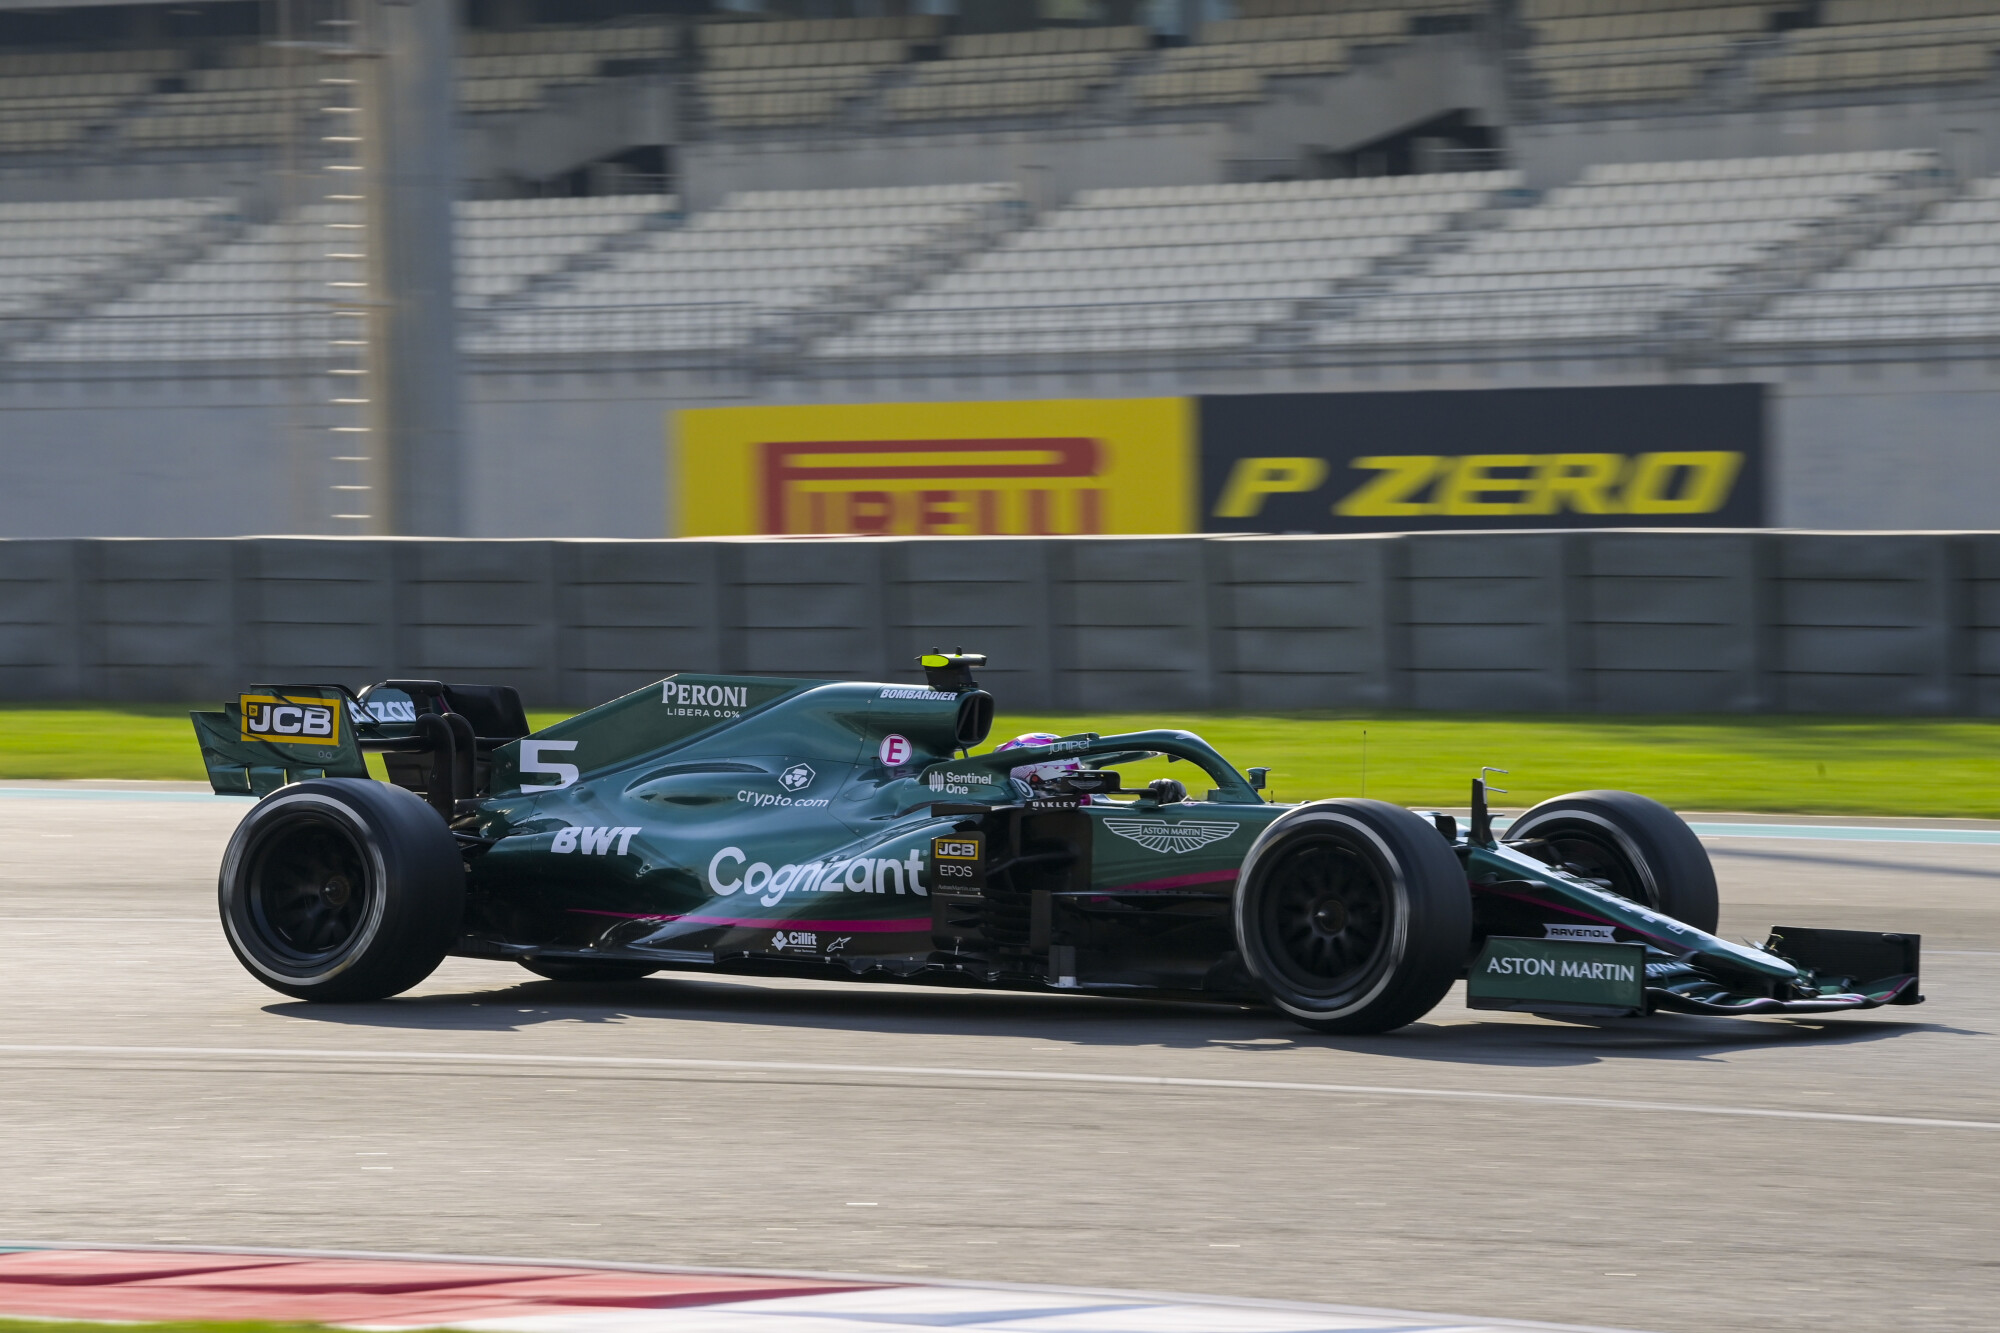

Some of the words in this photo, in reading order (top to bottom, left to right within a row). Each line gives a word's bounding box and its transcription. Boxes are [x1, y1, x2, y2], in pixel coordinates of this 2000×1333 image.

[1212, 457, 1328, 517] P
[1332, 451, 1744, 516] ZERO
[661, 680, 748, 707] PERONI
[880, 689, 958, 701] BOMBARDIER
[248, 705, 332, 735] JCB
[667, 707, 710, 717] LIBERA
[713, 710, 740, 719] 0.0%
[886, 737, 904, 763] E
[519, 739, 580, 794] 5
[946, 772, 992, 785] Sentinel
[946, 783, 969, 795] One
[736, 788, 830, 809] crypto.com
[1142, 826, 1170, 835] ASTON
[1171, 828, 1201, 836] MARTIN
[550, 826, 643, 857] BWT
[938, 842, 975, 856] JCB
[708, 846, 929, 908] Cognizant
[940, 864, 973, 877] EPOS
[788, 931, 817, 945] Cillit
[1550, 928, 1609, 938] RAVENOL
[1486, 956, 1555, 976] ASTON
[1560, 960, 1635, 982] MARTIN
